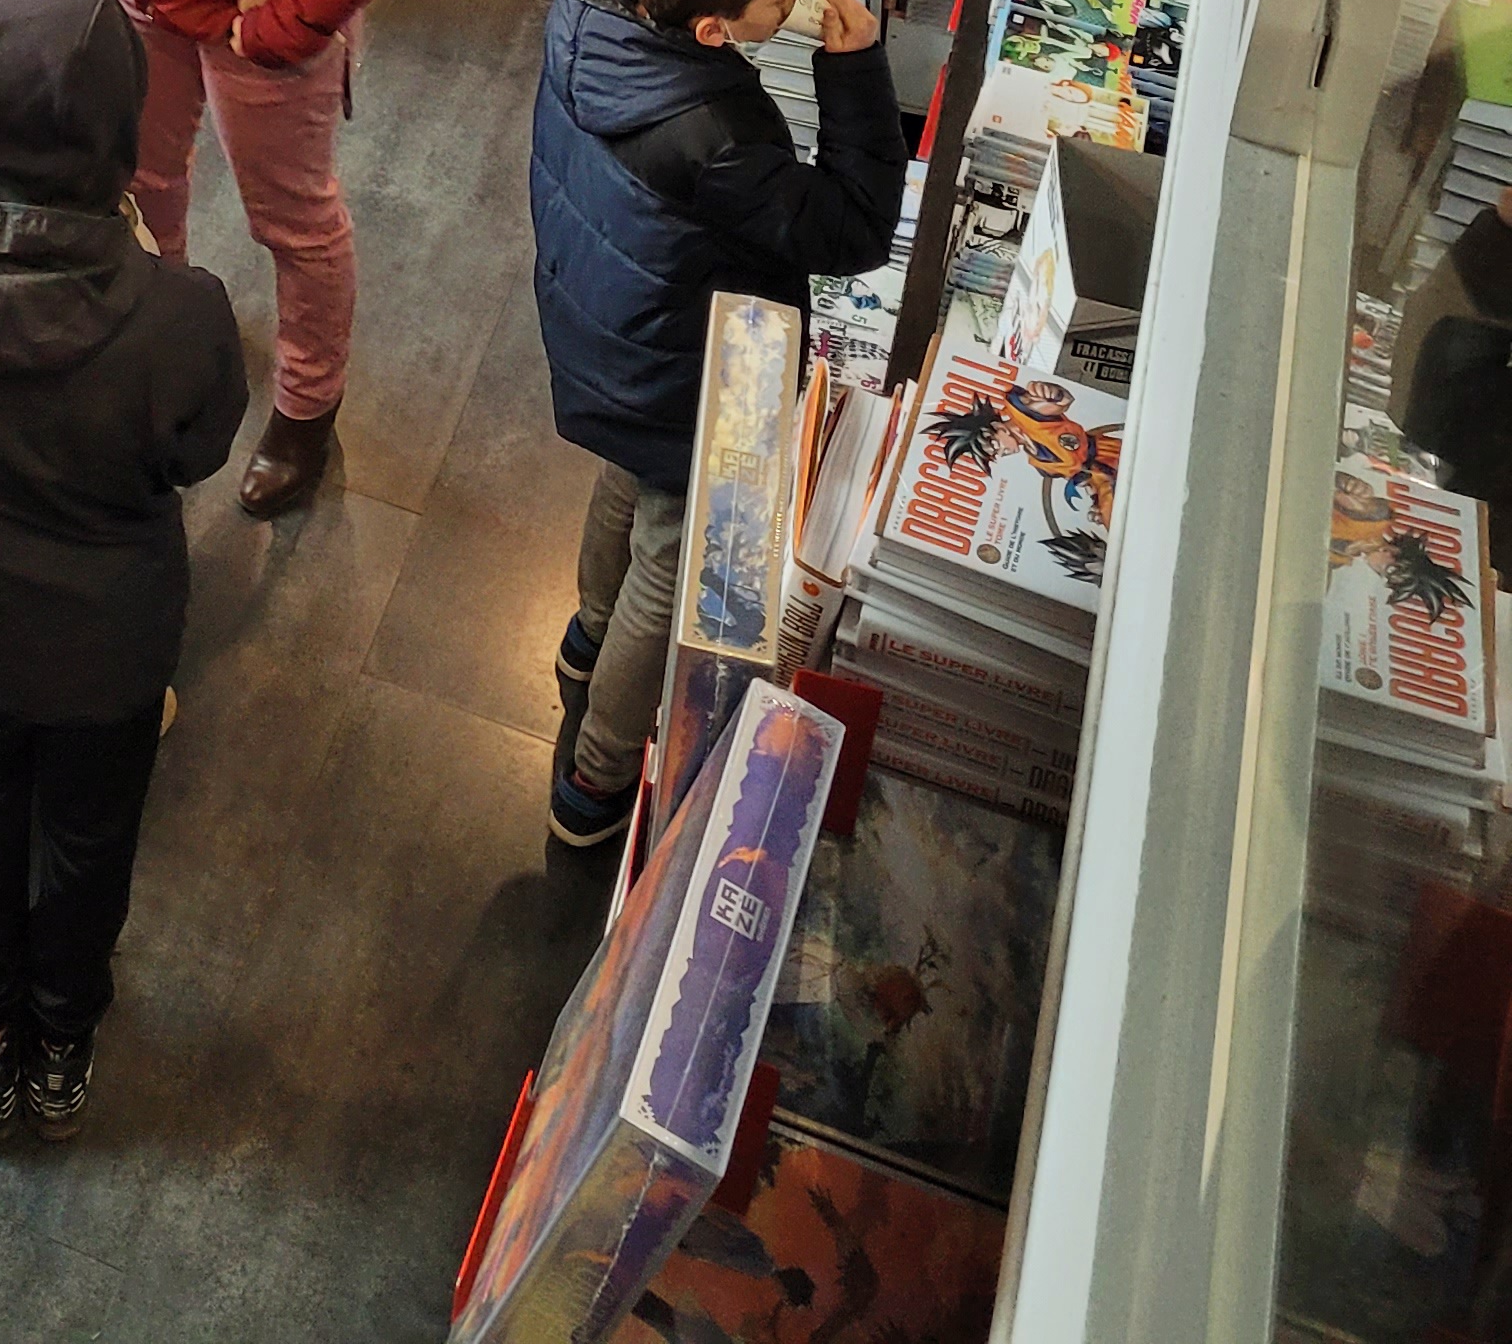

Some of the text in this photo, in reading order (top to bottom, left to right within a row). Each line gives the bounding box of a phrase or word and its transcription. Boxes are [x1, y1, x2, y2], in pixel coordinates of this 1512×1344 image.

[985, 478, 1008, 542] LE SUPER LIVRE
[994, 522, 1007, 545] TOME
[890, 639, 1055, 701] LE SUPER LIVRE
